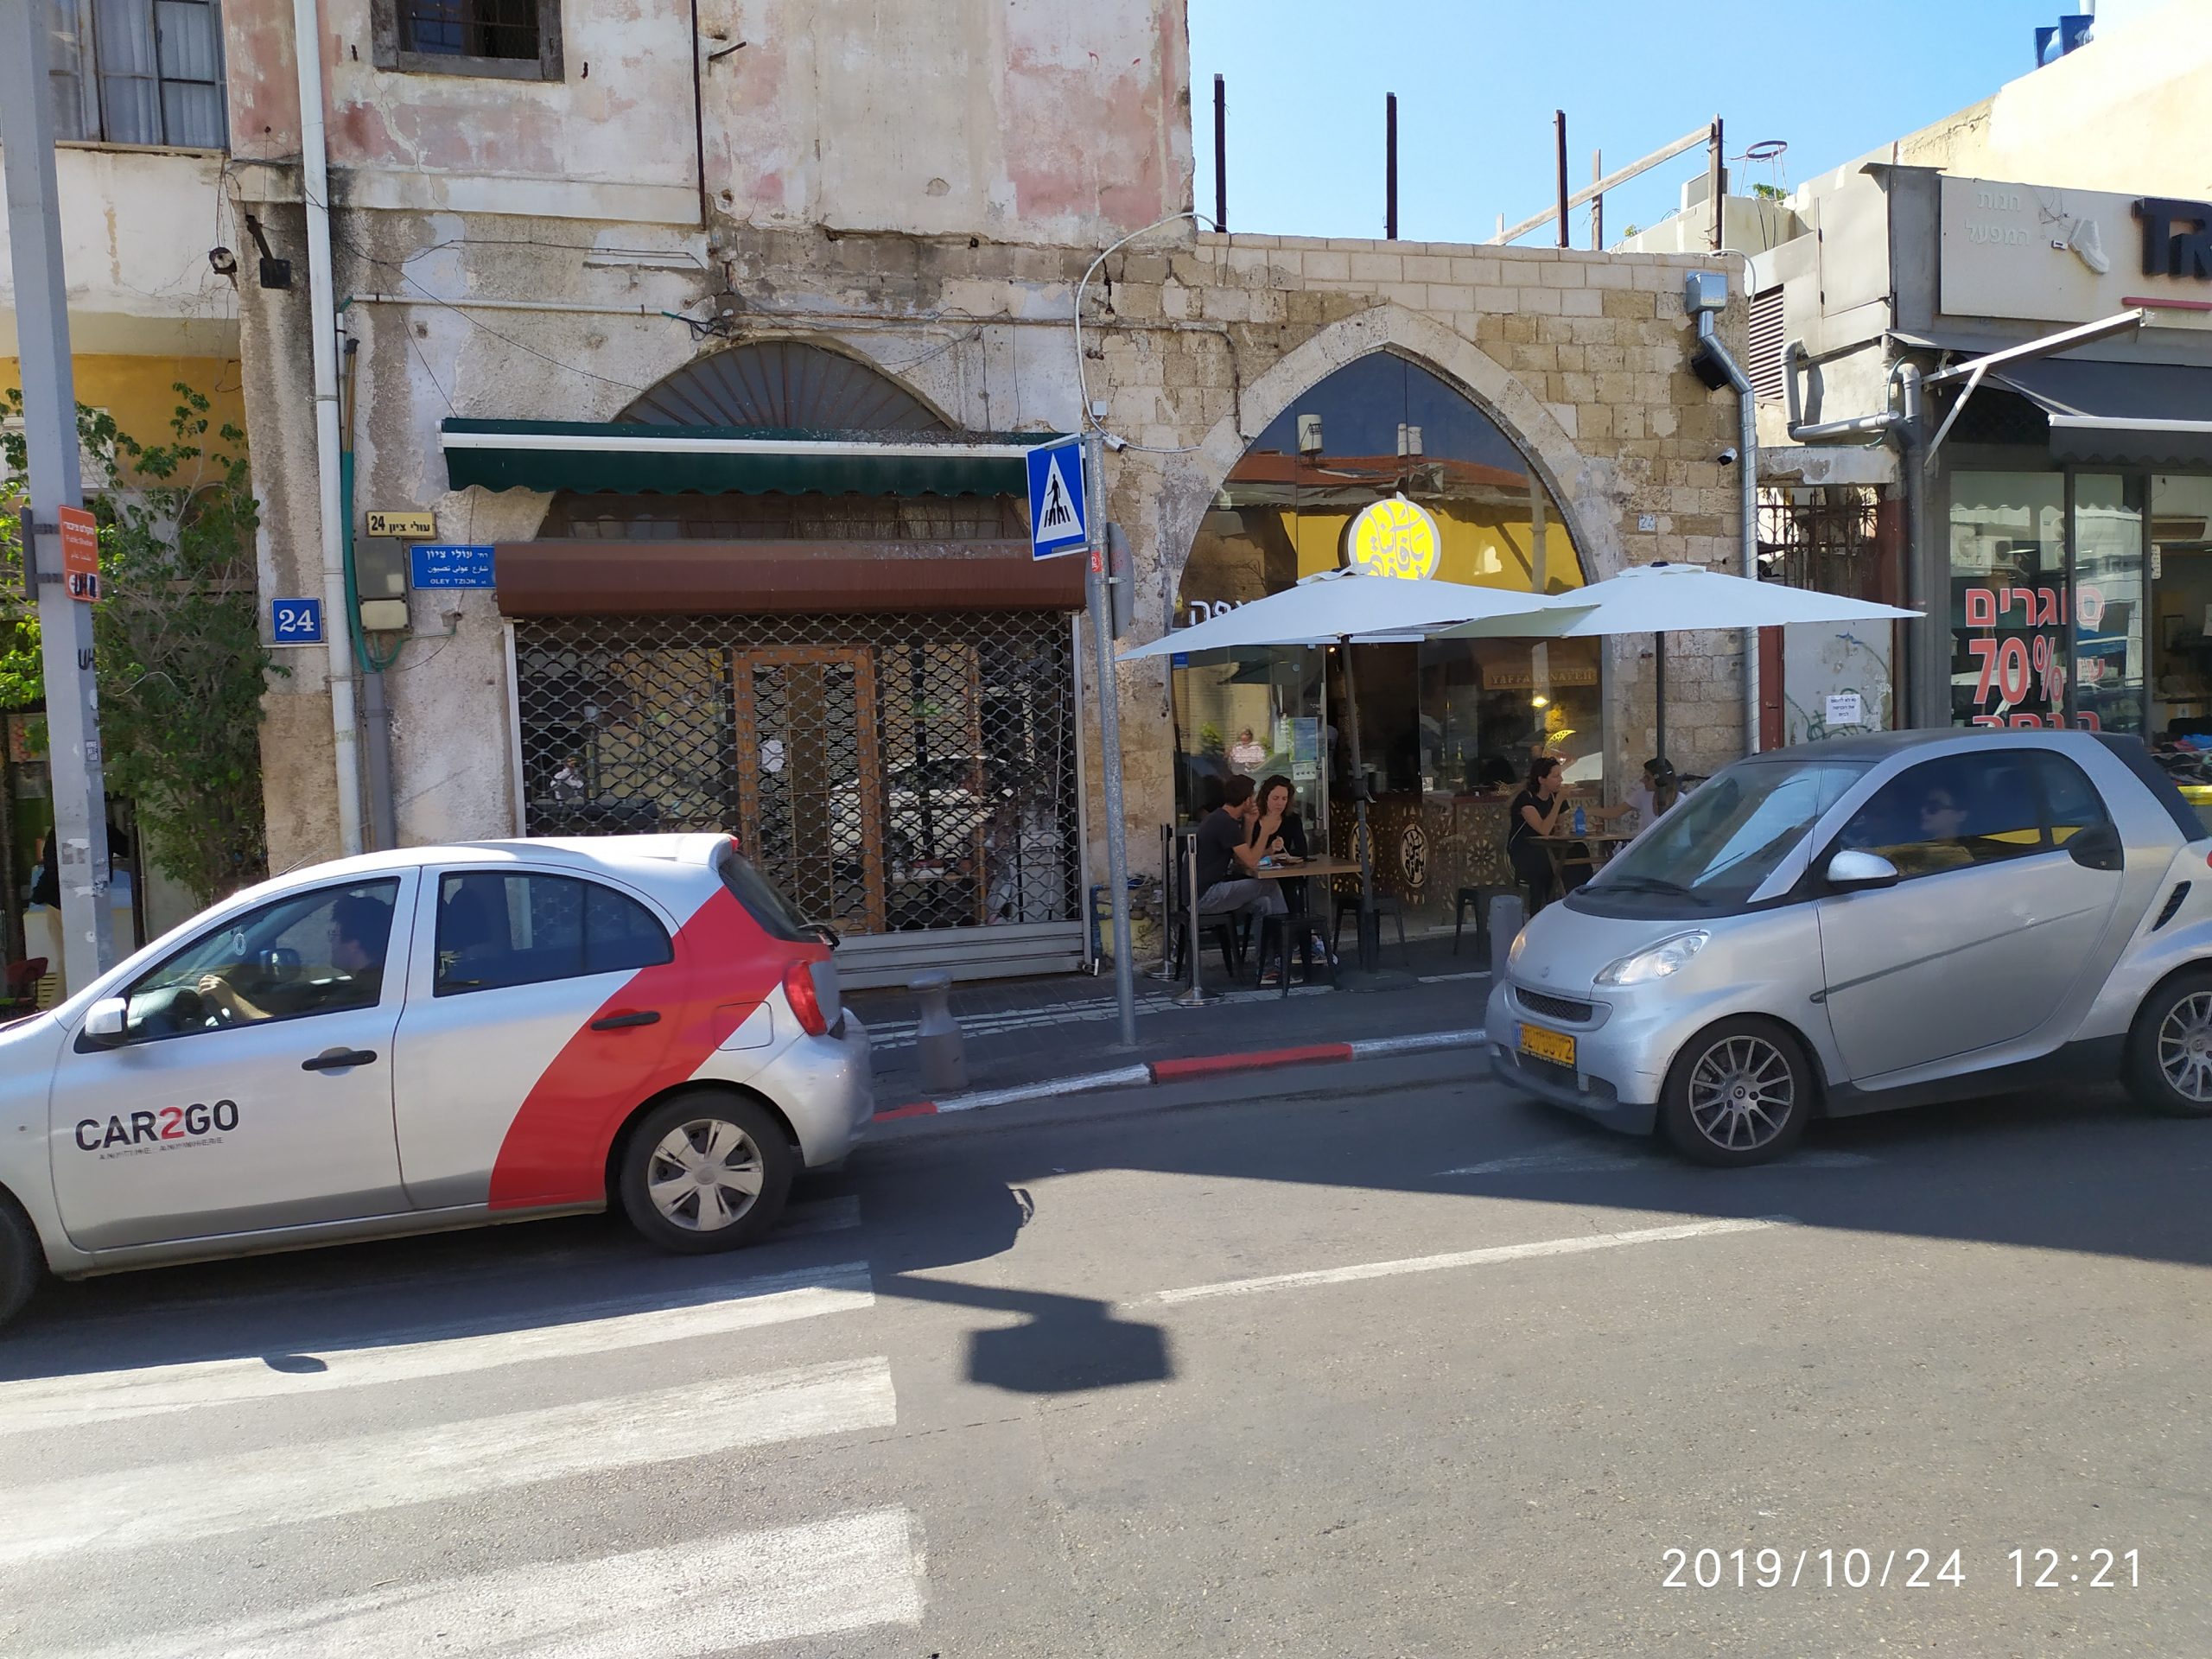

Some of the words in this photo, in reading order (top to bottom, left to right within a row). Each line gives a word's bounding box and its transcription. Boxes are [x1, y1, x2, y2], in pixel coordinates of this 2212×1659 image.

[371, 515, 385, 531] 24
[389, 522, 407, 534] ציון
[410, 520, 430, 532] עולי
[1965, 587, 2105, 628] סוגרים
[278, 608, 315, 632] 24
[1968, 634, 2064, 706] 70%
[75, 1099, 239, 1151] CAR2GO
